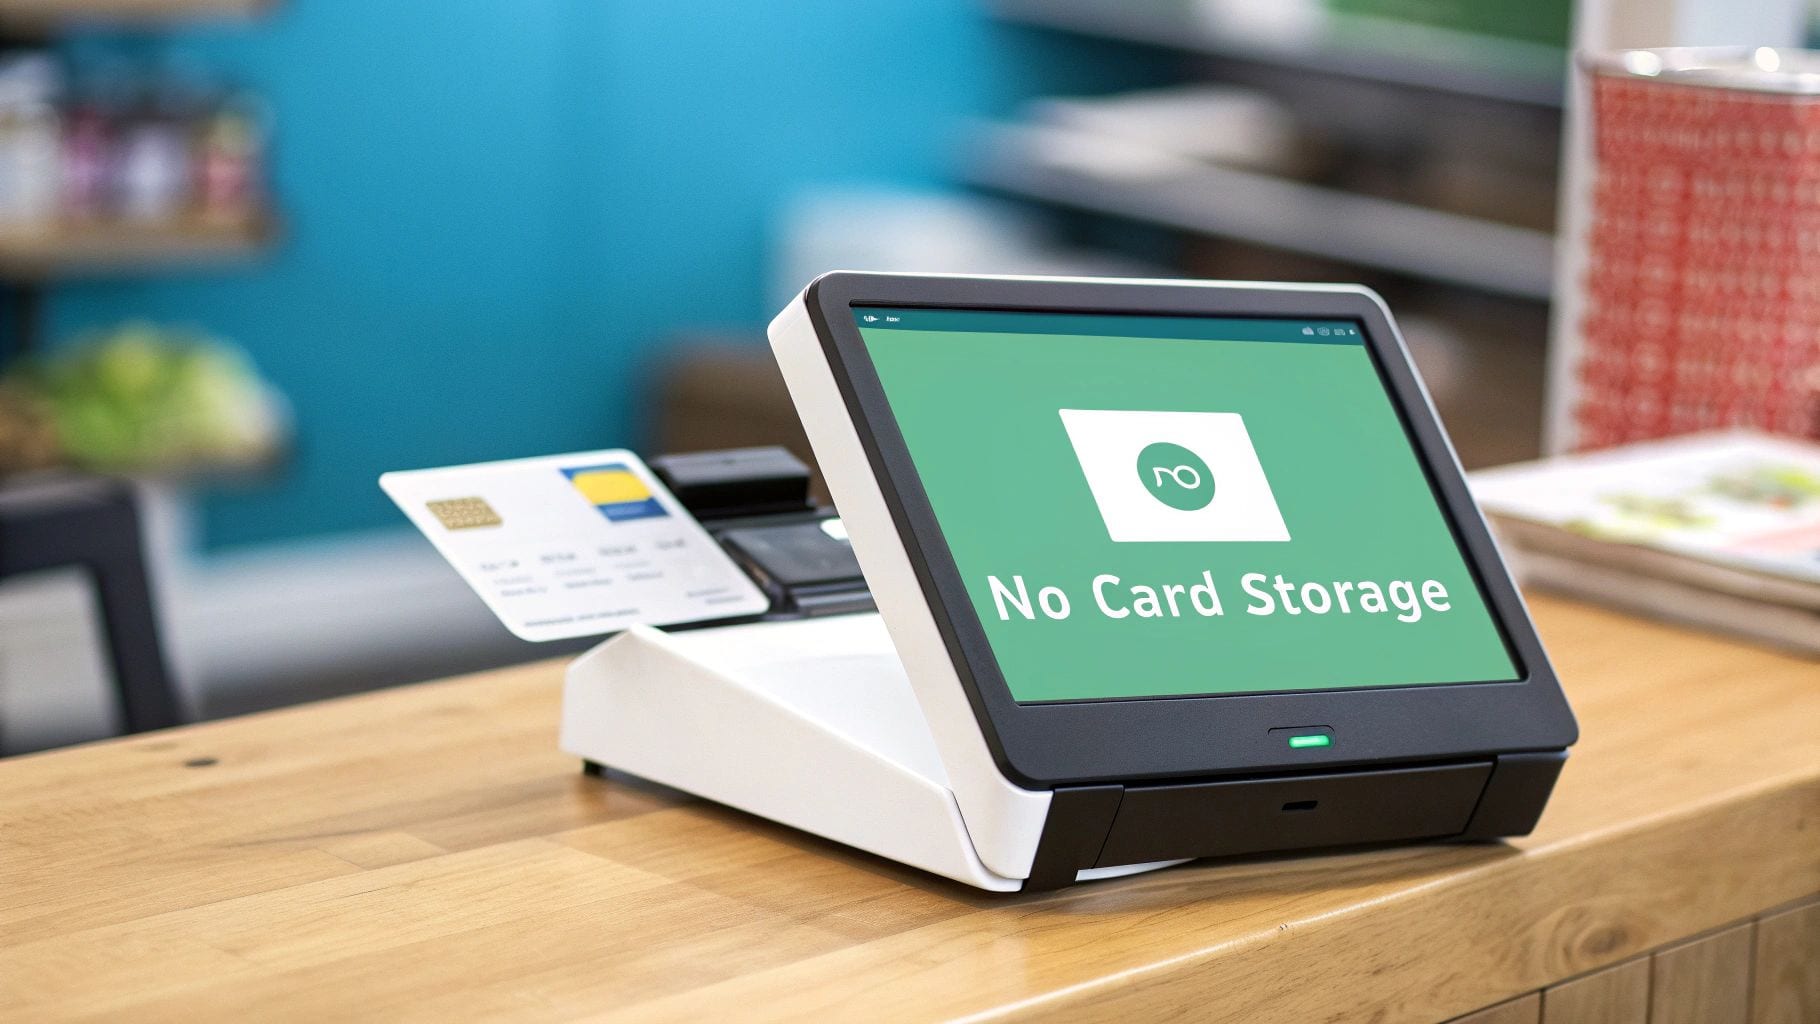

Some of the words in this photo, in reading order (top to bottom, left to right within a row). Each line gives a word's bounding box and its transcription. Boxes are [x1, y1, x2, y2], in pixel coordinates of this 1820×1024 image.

[987, 575, 1071, 620] No
[1092, 570, 1224, 619] Card
[1240, 572, 1452, 623] Storage
